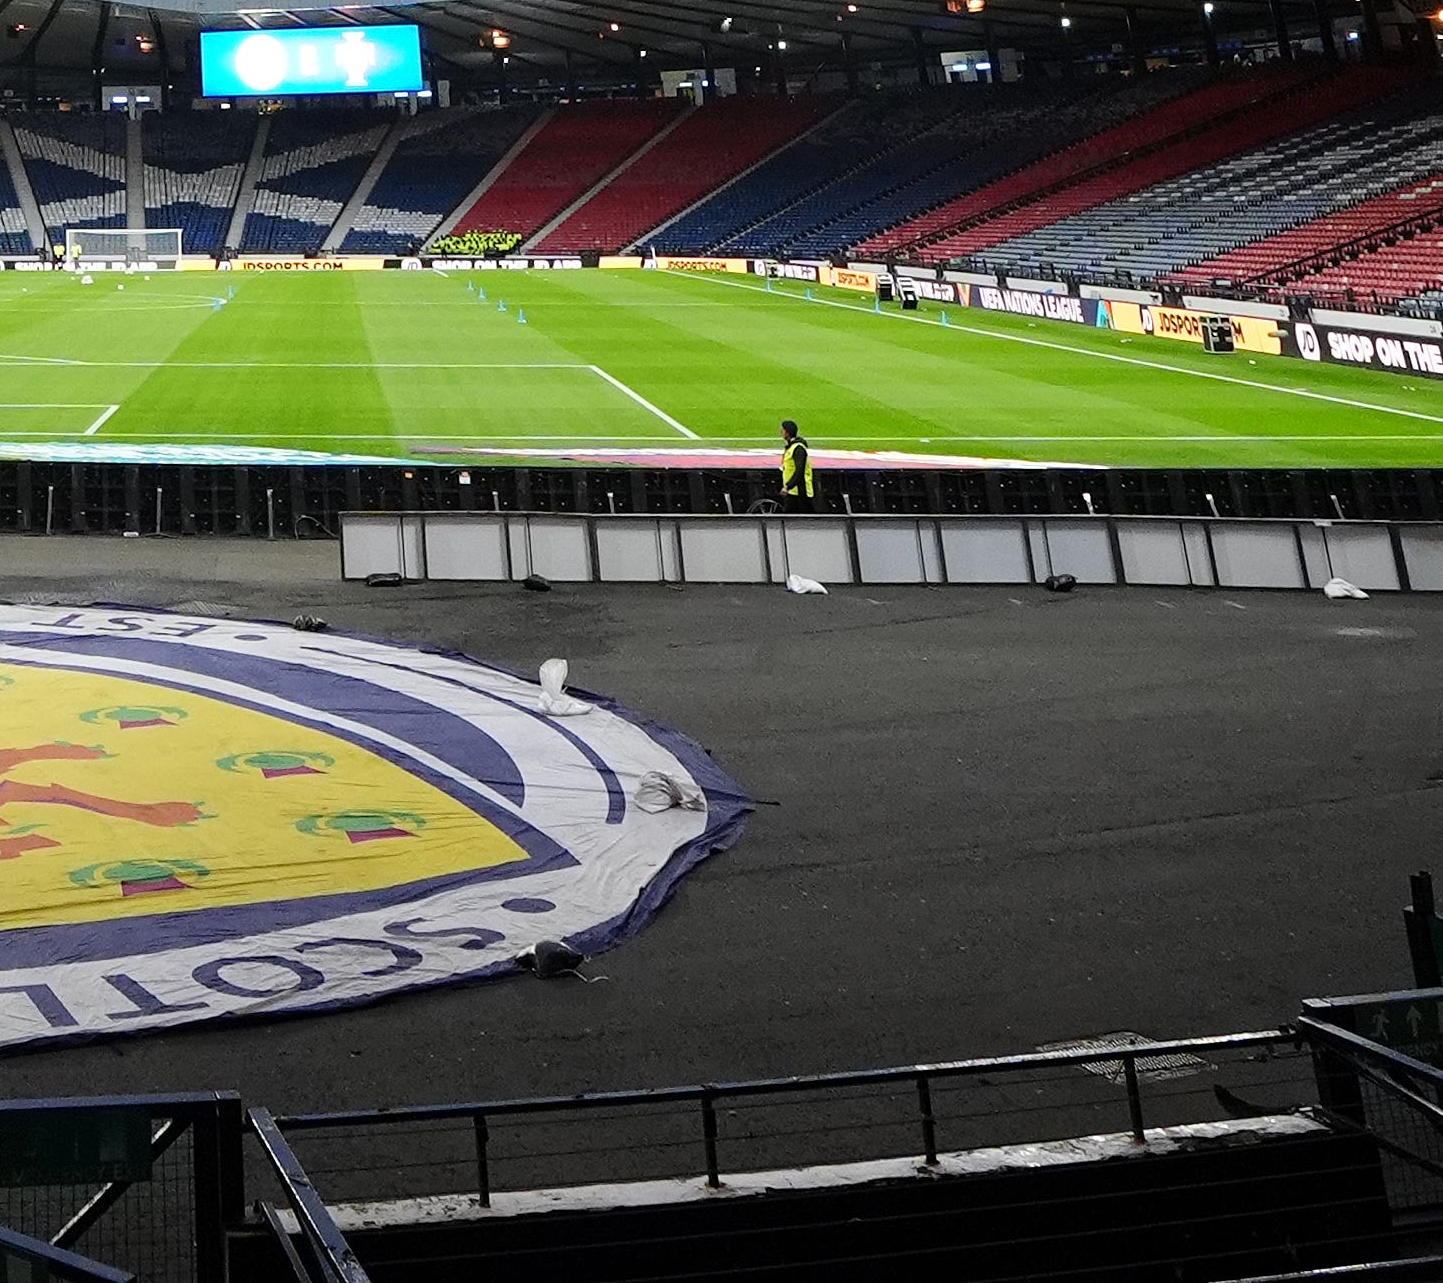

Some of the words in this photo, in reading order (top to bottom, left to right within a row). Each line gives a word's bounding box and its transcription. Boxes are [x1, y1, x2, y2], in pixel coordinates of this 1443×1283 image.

[979, 287, 1005, 312] UEFA
[1002, 290, 1044, 317] NATIONS
[1044, 294, 1085, 323] LEAGUE
[1159, 312, 1245, 343] JDSPORM
[1327, 332, 1374, 364] SHOP
[1375, 337, 1407, 369] ON
[31, 612, 218, 638] EST
